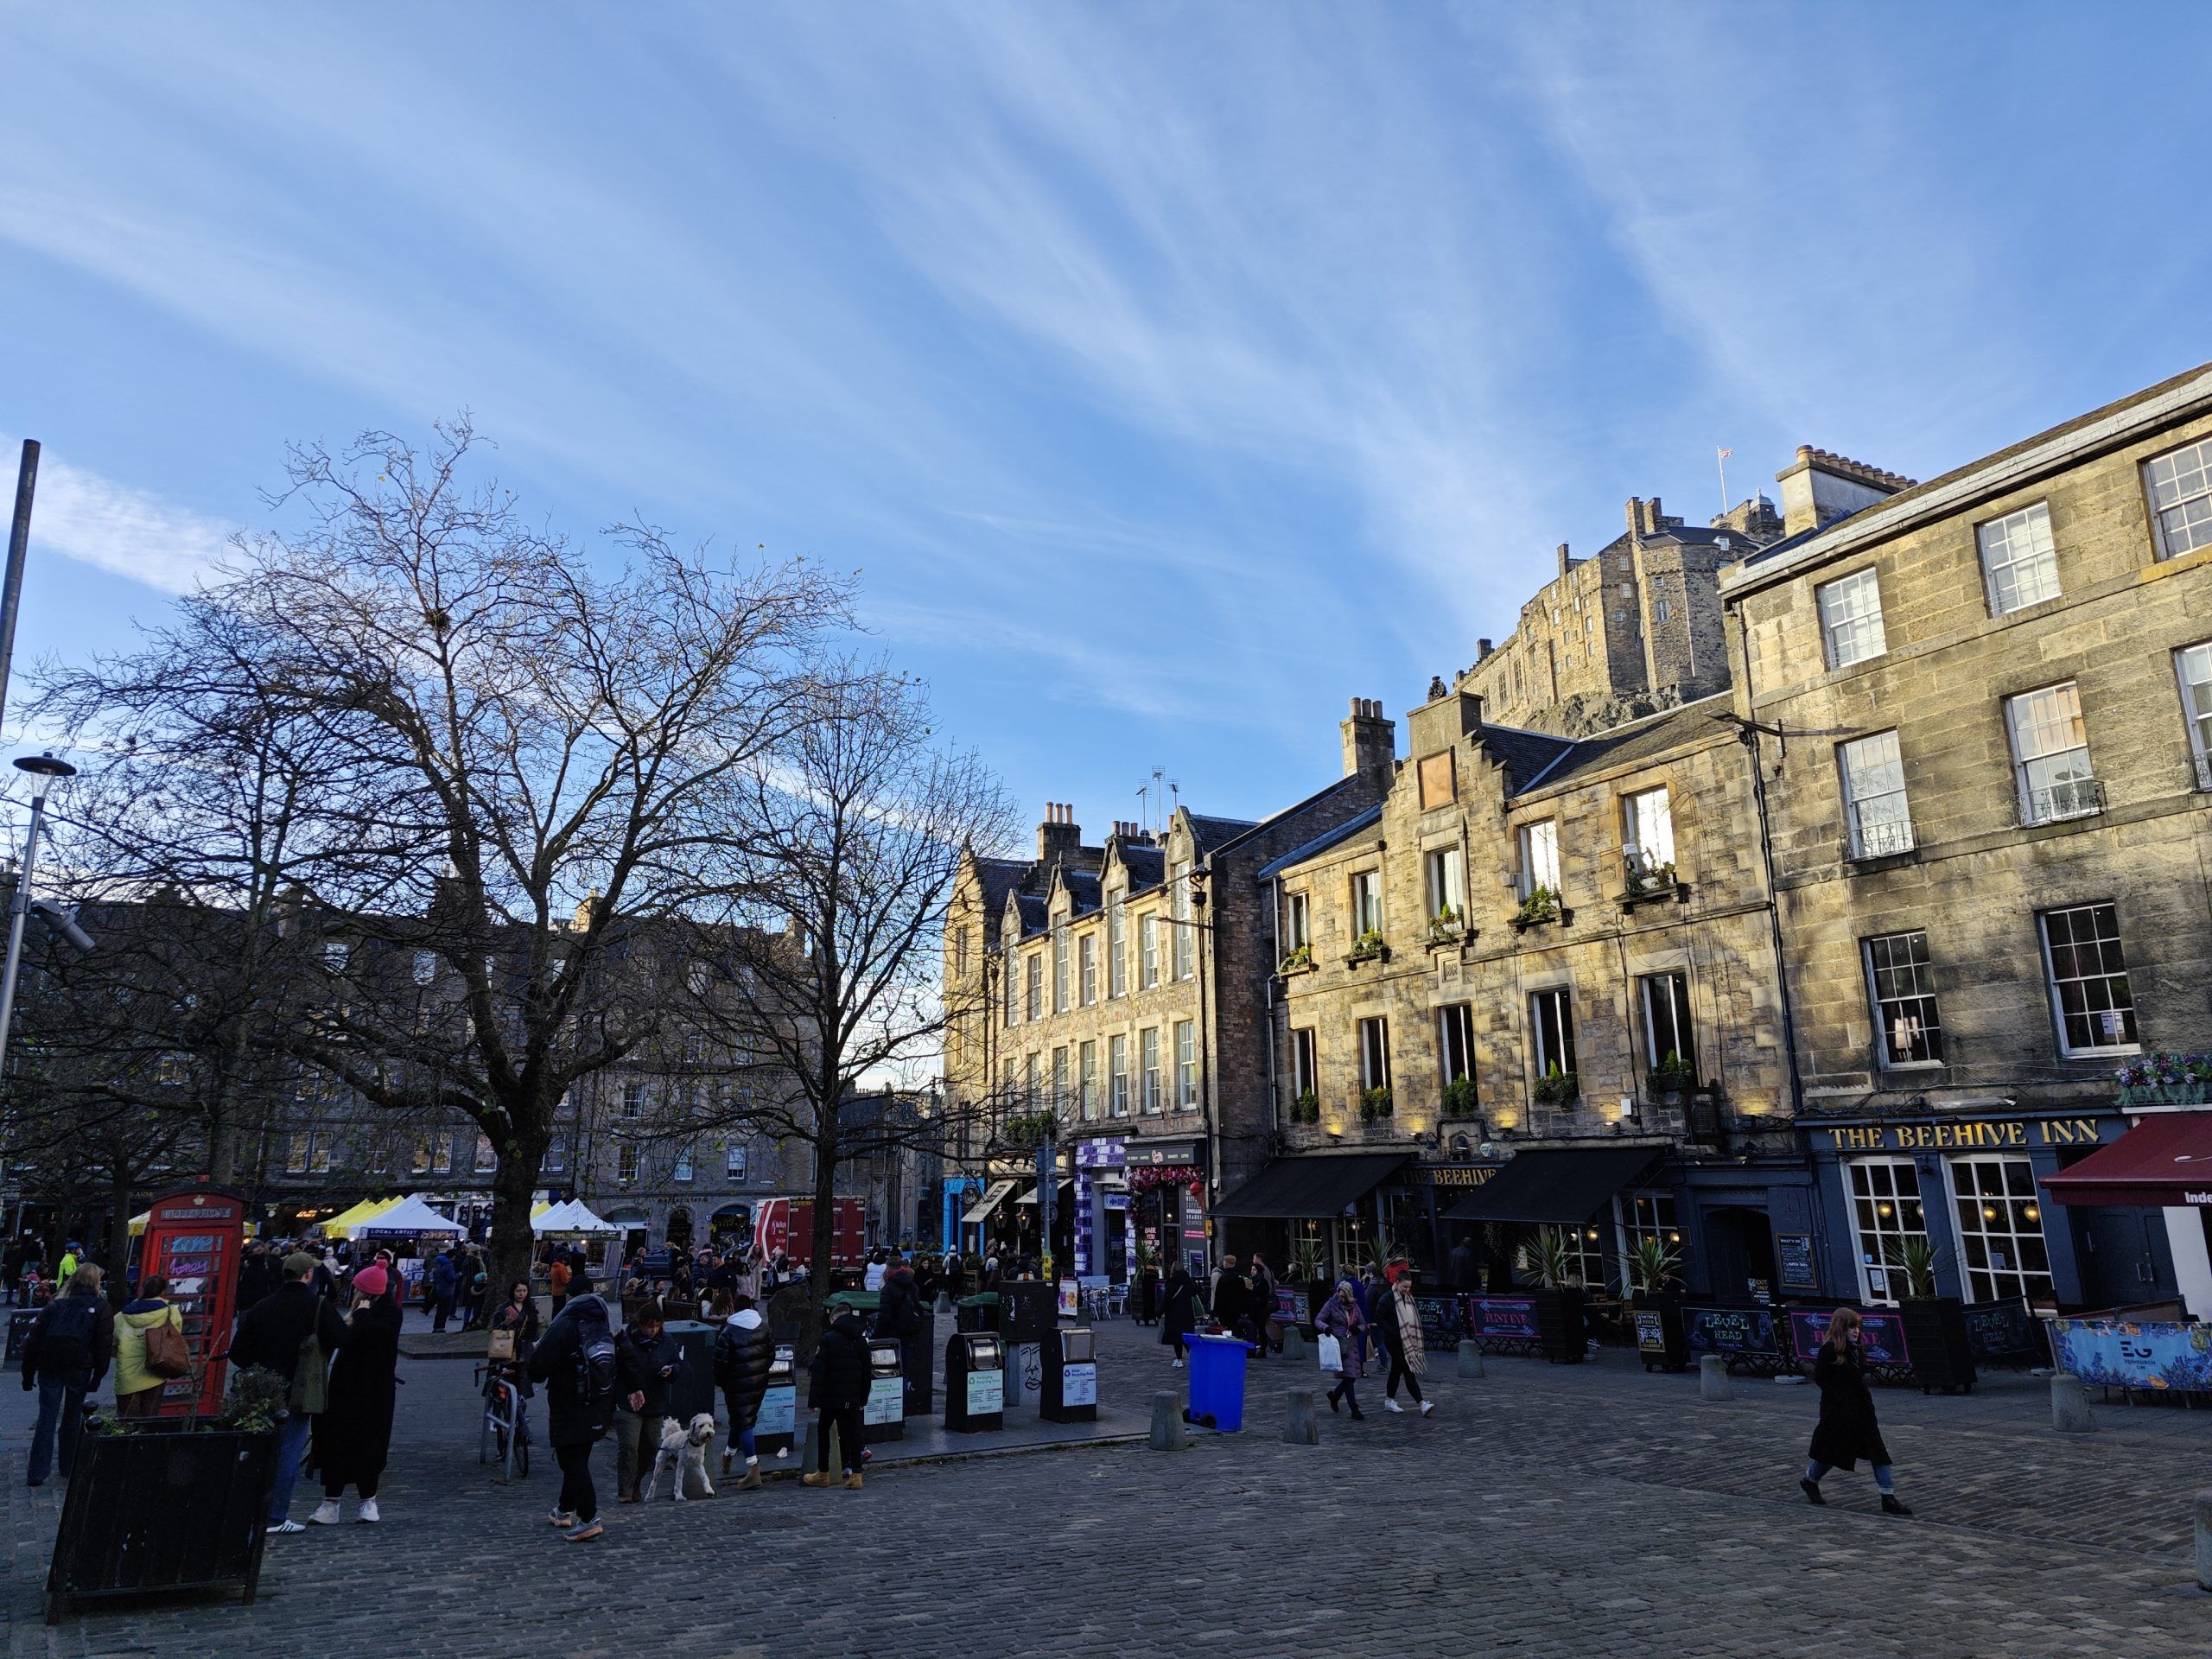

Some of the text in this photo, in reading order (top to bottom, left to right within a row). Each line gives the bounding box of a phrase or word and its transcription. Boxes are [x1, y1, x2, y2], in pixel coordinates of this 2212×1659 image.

[1828, 1119, 2100, 1148] THE BEEHIVE INN
[1417, 1300, 1444, 1314] EVEL
[1705, 1313, 1750, 1330] LEVEL
[1714, 1331, 1743, 1340] HEAD
